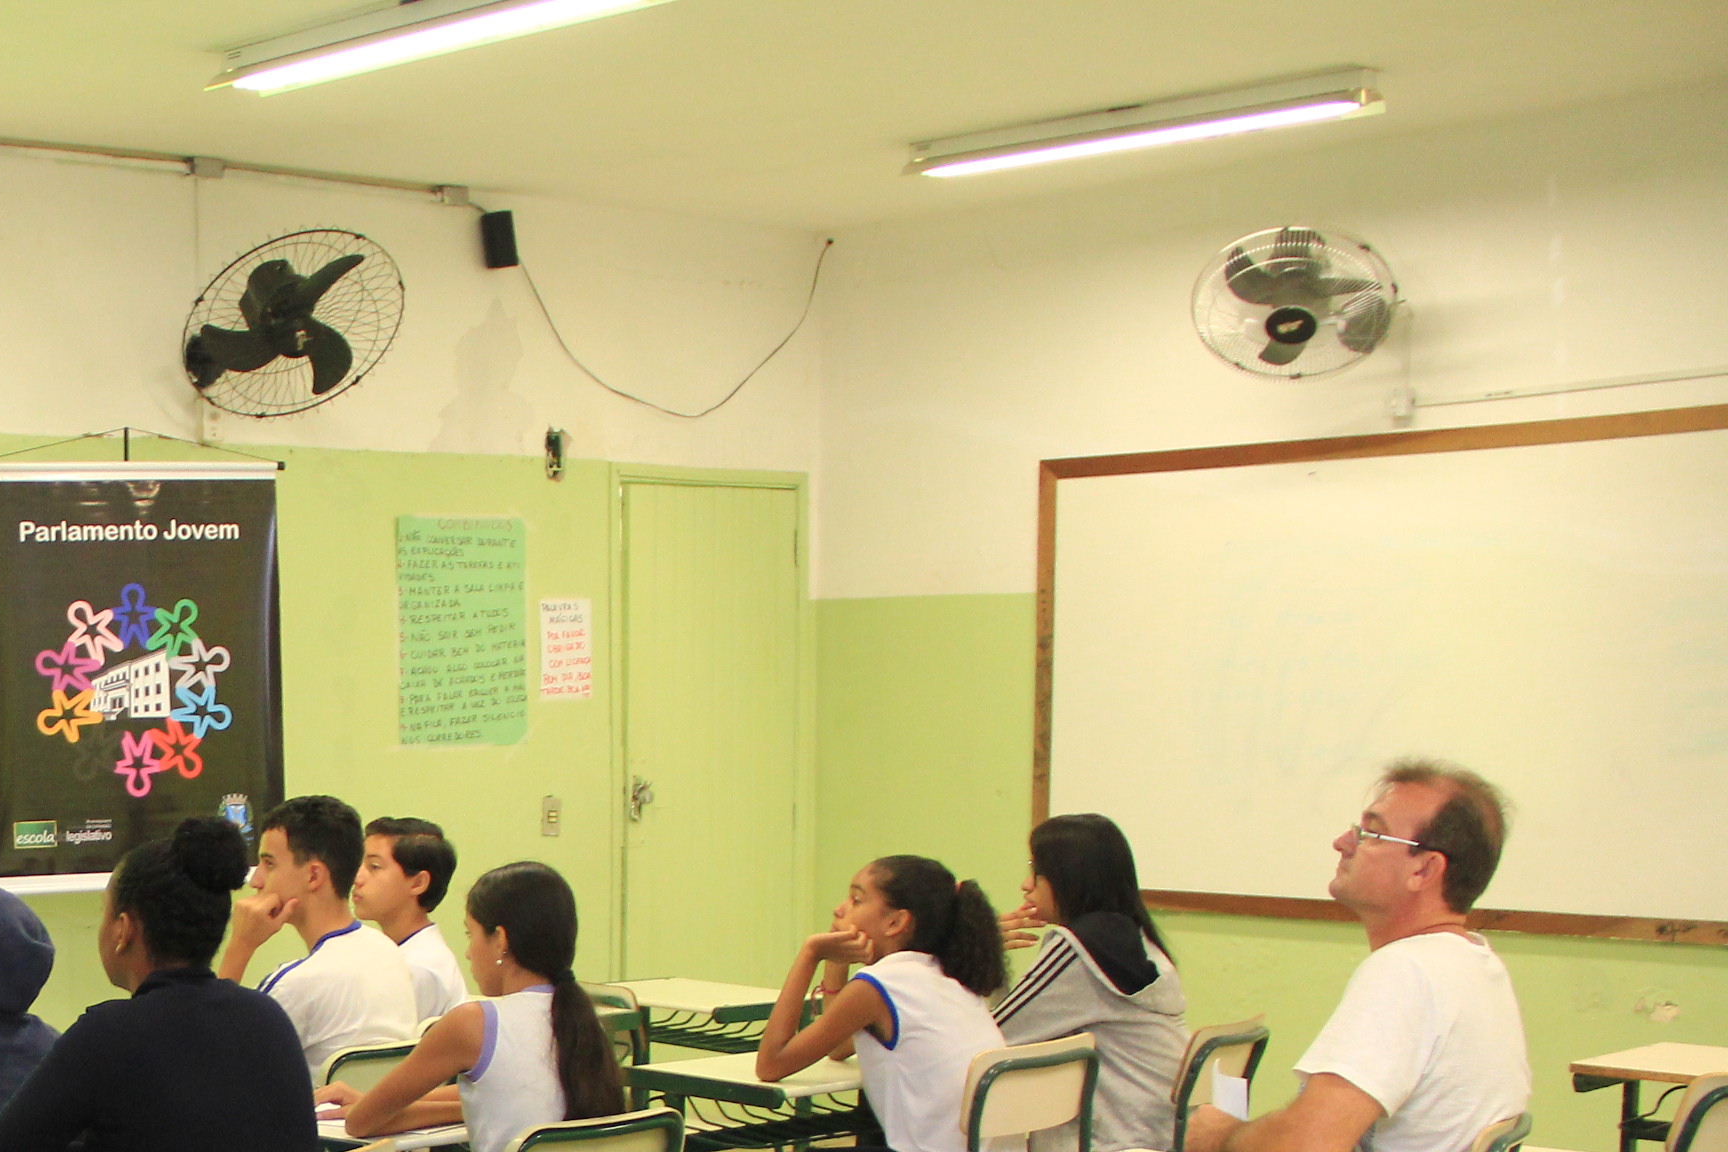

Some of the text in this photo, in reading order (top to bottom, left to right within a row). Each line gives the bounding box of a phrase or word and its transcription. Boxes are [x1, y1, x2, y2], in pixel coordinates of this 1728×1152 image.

[19, 518, 240, 542] Parlamento Jovem
[16, 830, 55, 844] escola
[66, 830, 112, 845] legislativo
